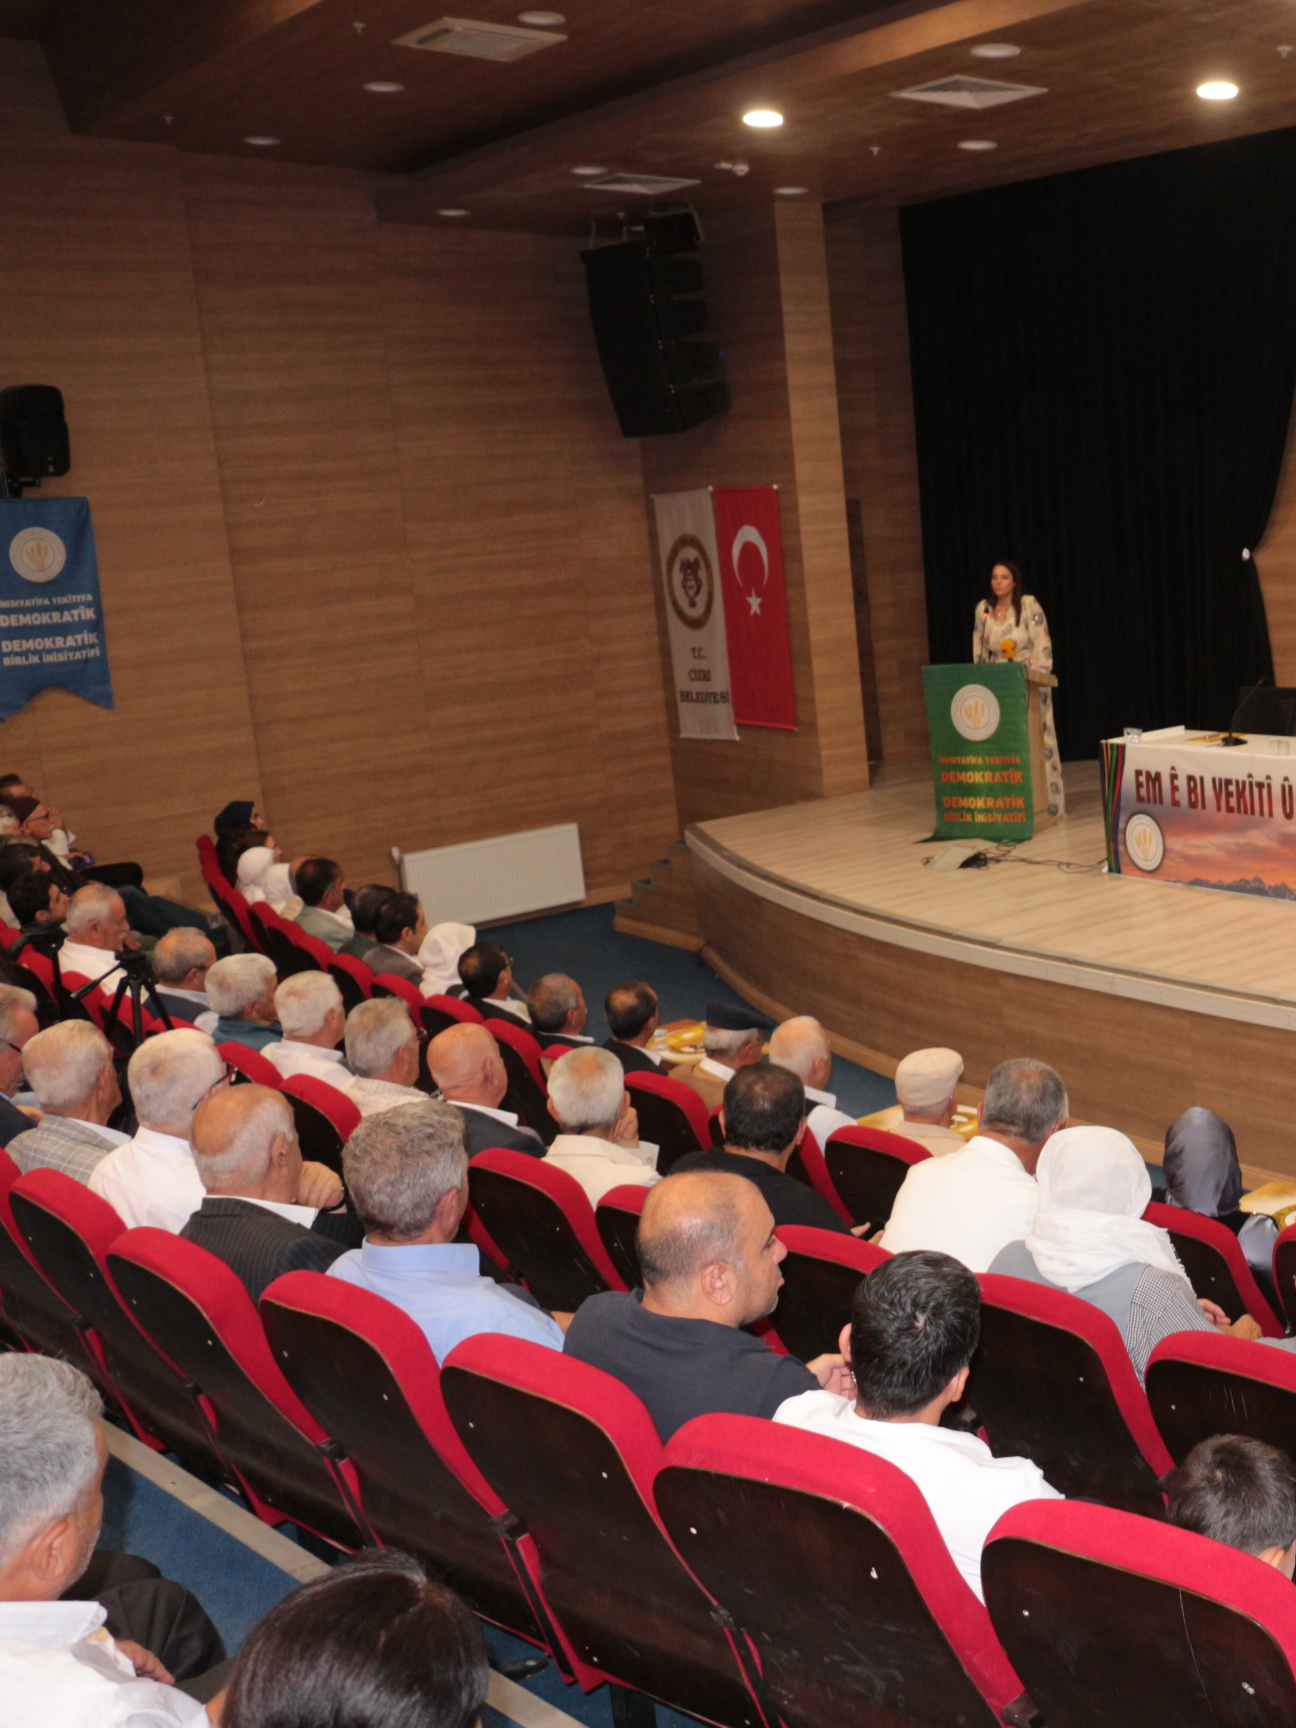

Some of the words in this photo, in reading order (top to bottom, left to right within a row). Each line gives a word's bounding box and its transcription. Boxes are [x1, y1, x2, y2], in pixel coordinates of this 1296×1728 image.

[1, 630, 99, 652] DEMOKRATİK
[3, 653, 40, 666] BİRLİK
[1134, 769, 1163, 805] EM
[1169, 766, 1181, 807] Ê
[1186, 774, 1206, 811] BI
[1211, 773, 1274, 818] YEKÎTÎ
[1280, 776, 1294, 820] Û
